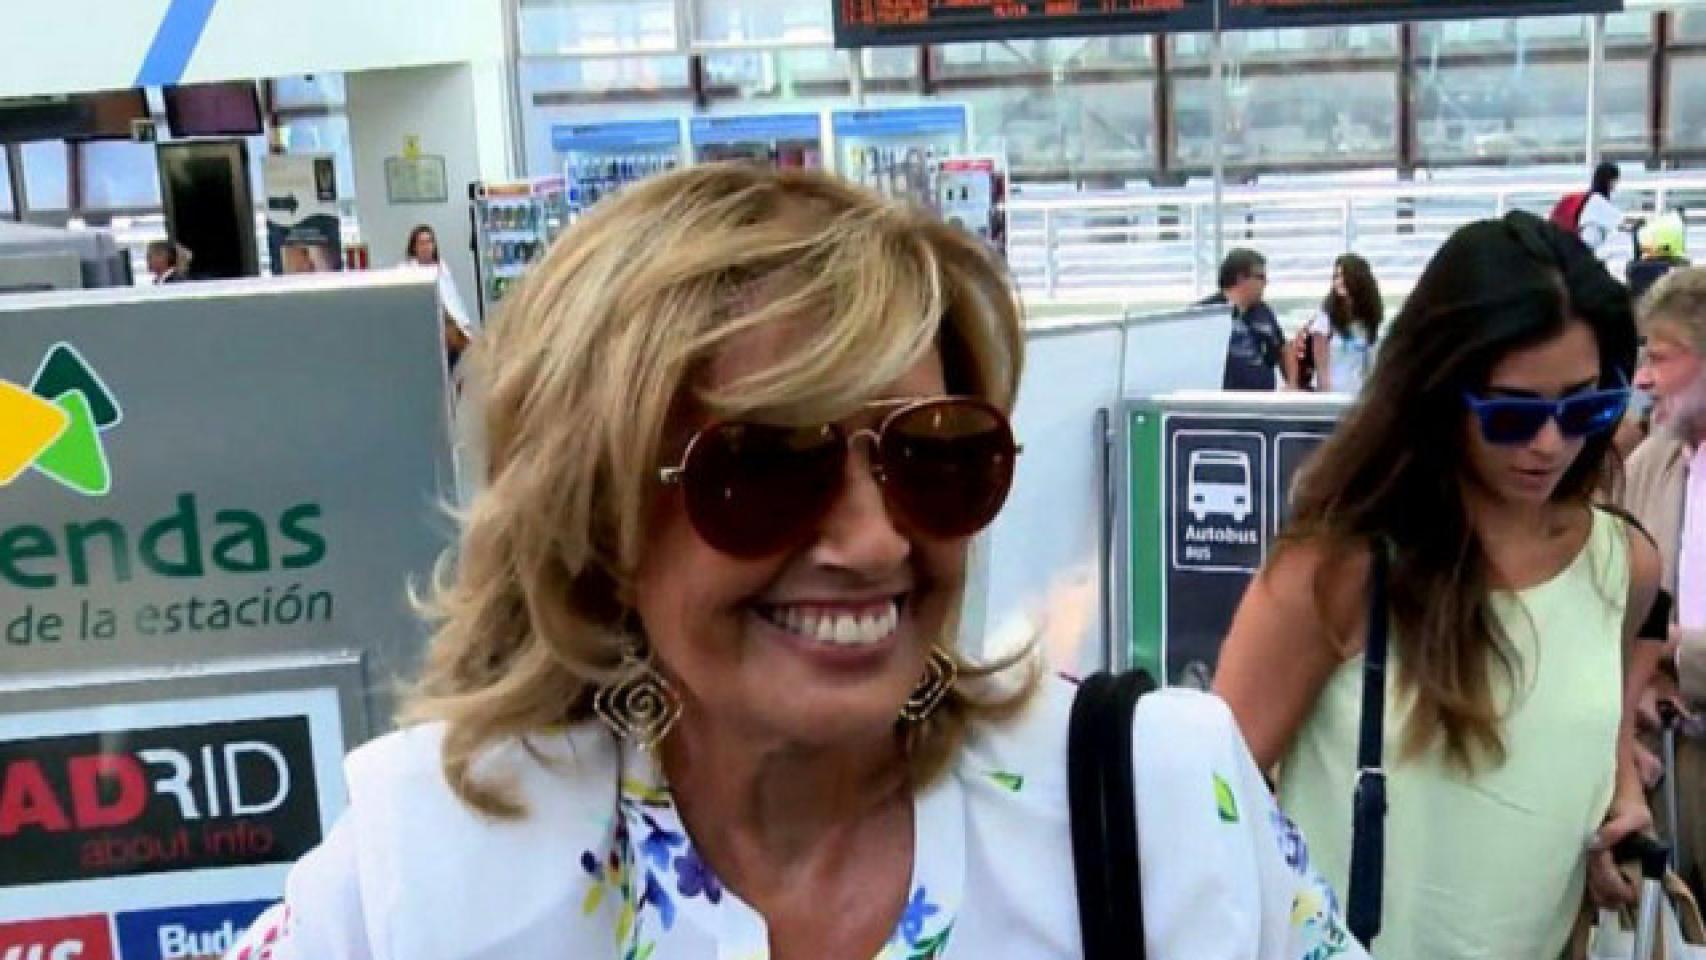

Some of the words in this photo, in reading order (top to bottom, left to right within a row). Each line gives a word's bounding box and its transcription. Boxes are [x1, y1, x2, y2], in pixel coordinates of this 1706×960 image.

[0, 493, 327, 588] endas
[6, 604, 63, 645] de
[79, 600, 116, 640] la
[135, 584, 332, 634] estación
